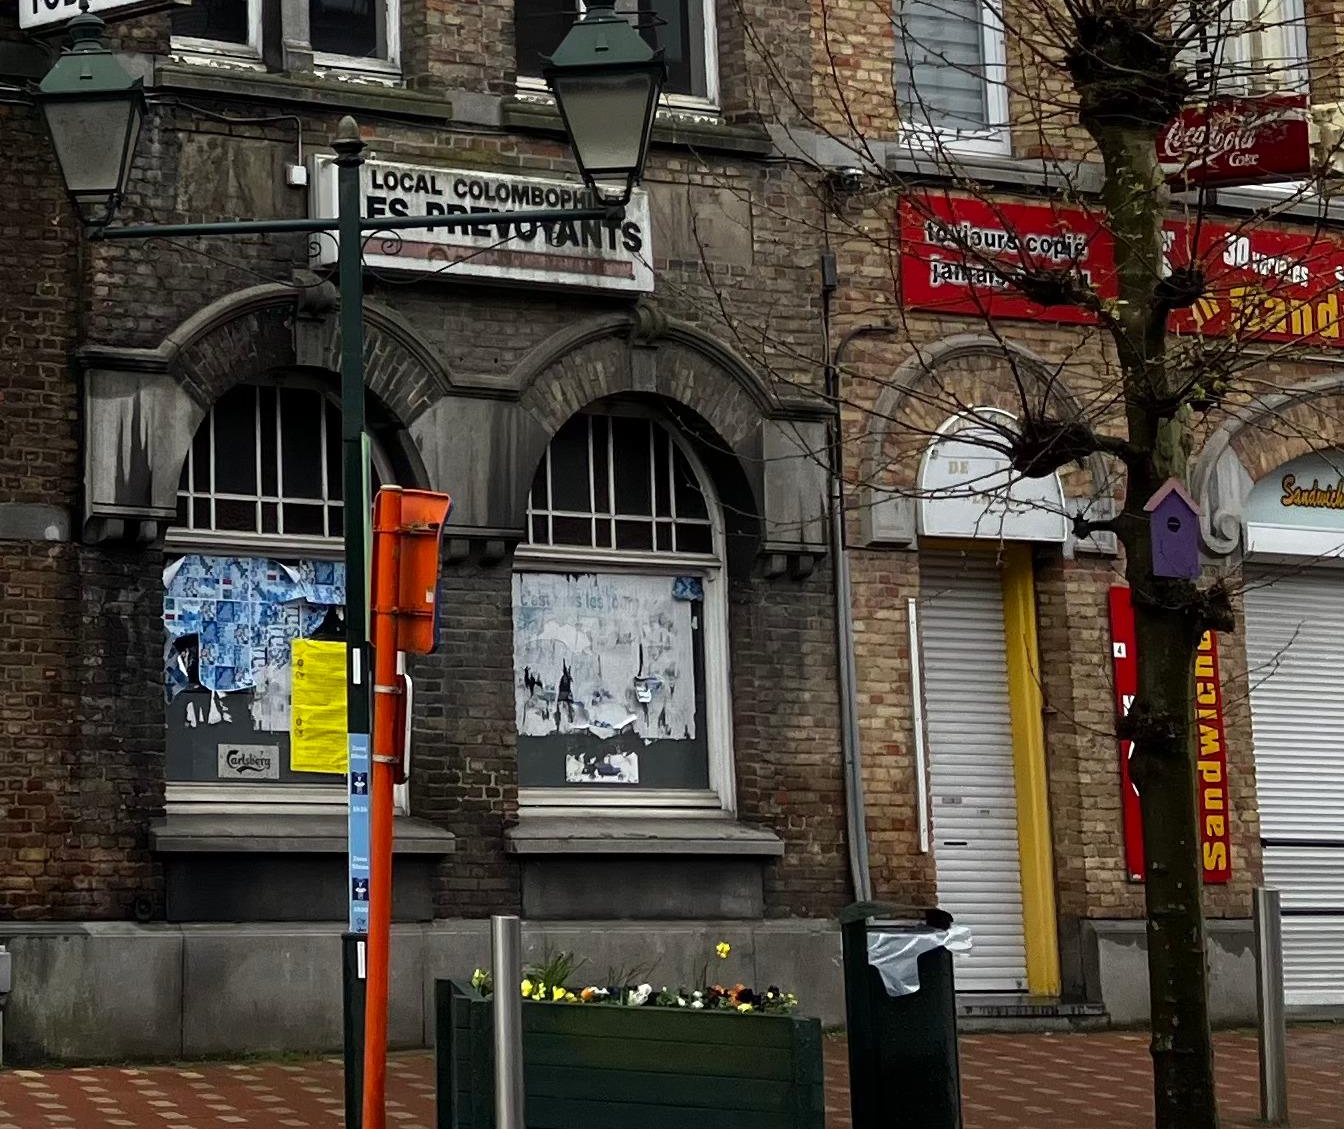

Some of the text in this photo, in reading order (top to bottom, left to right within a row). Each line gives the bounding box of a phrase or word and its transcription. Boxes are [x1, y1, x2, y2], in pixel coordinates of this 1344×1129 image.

[371, 170, 443, 196] LOCAL
[1223, 232, 1250, 269] 30
[1116, 644, 1123, 655] 4
[226, 749, 271, 771] Carlsberg
